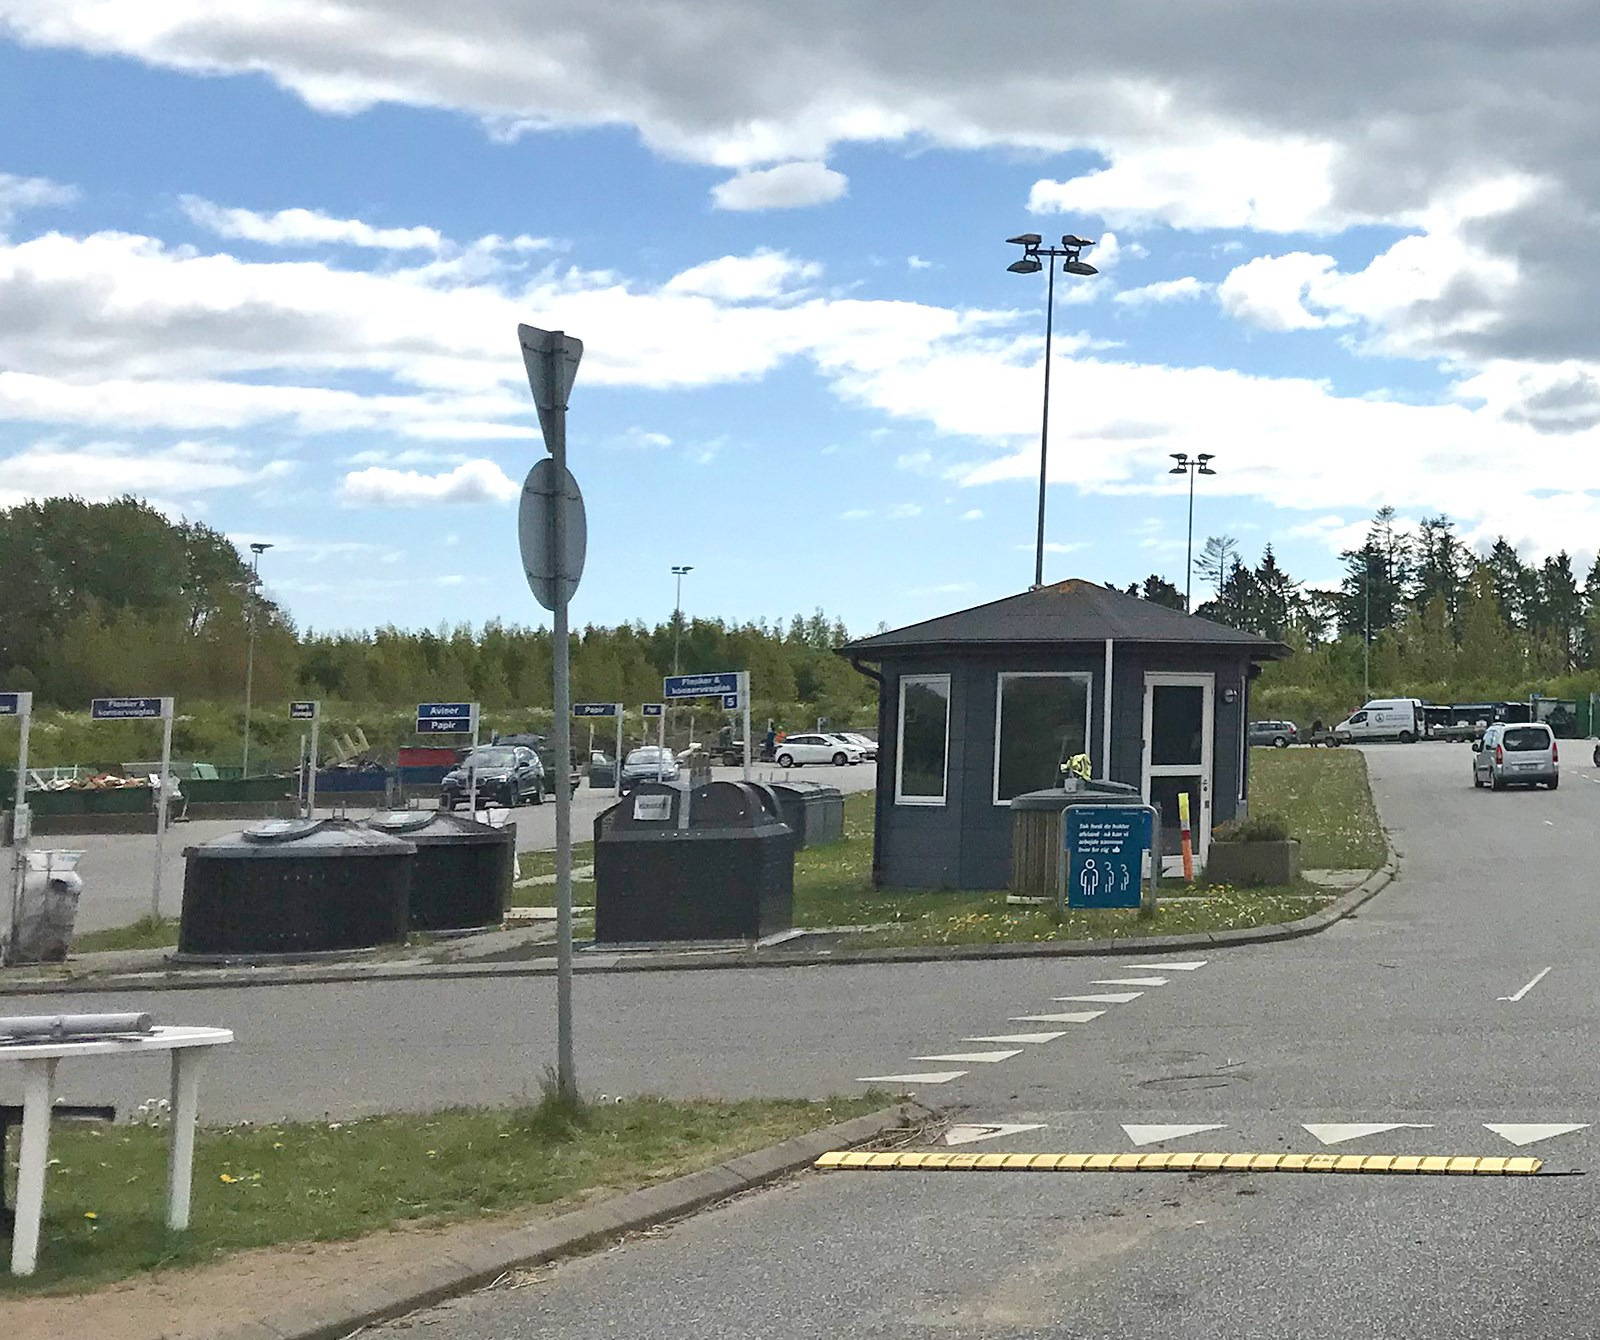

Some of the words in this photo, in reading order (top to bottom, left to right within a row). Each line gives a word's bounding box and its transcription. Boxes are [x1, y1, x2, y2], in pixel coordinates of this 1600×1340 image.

[726, 697, 735, 707] 5
[430, 706, 459, 715] Aviser
[431, 721, 456, 730] Papir
